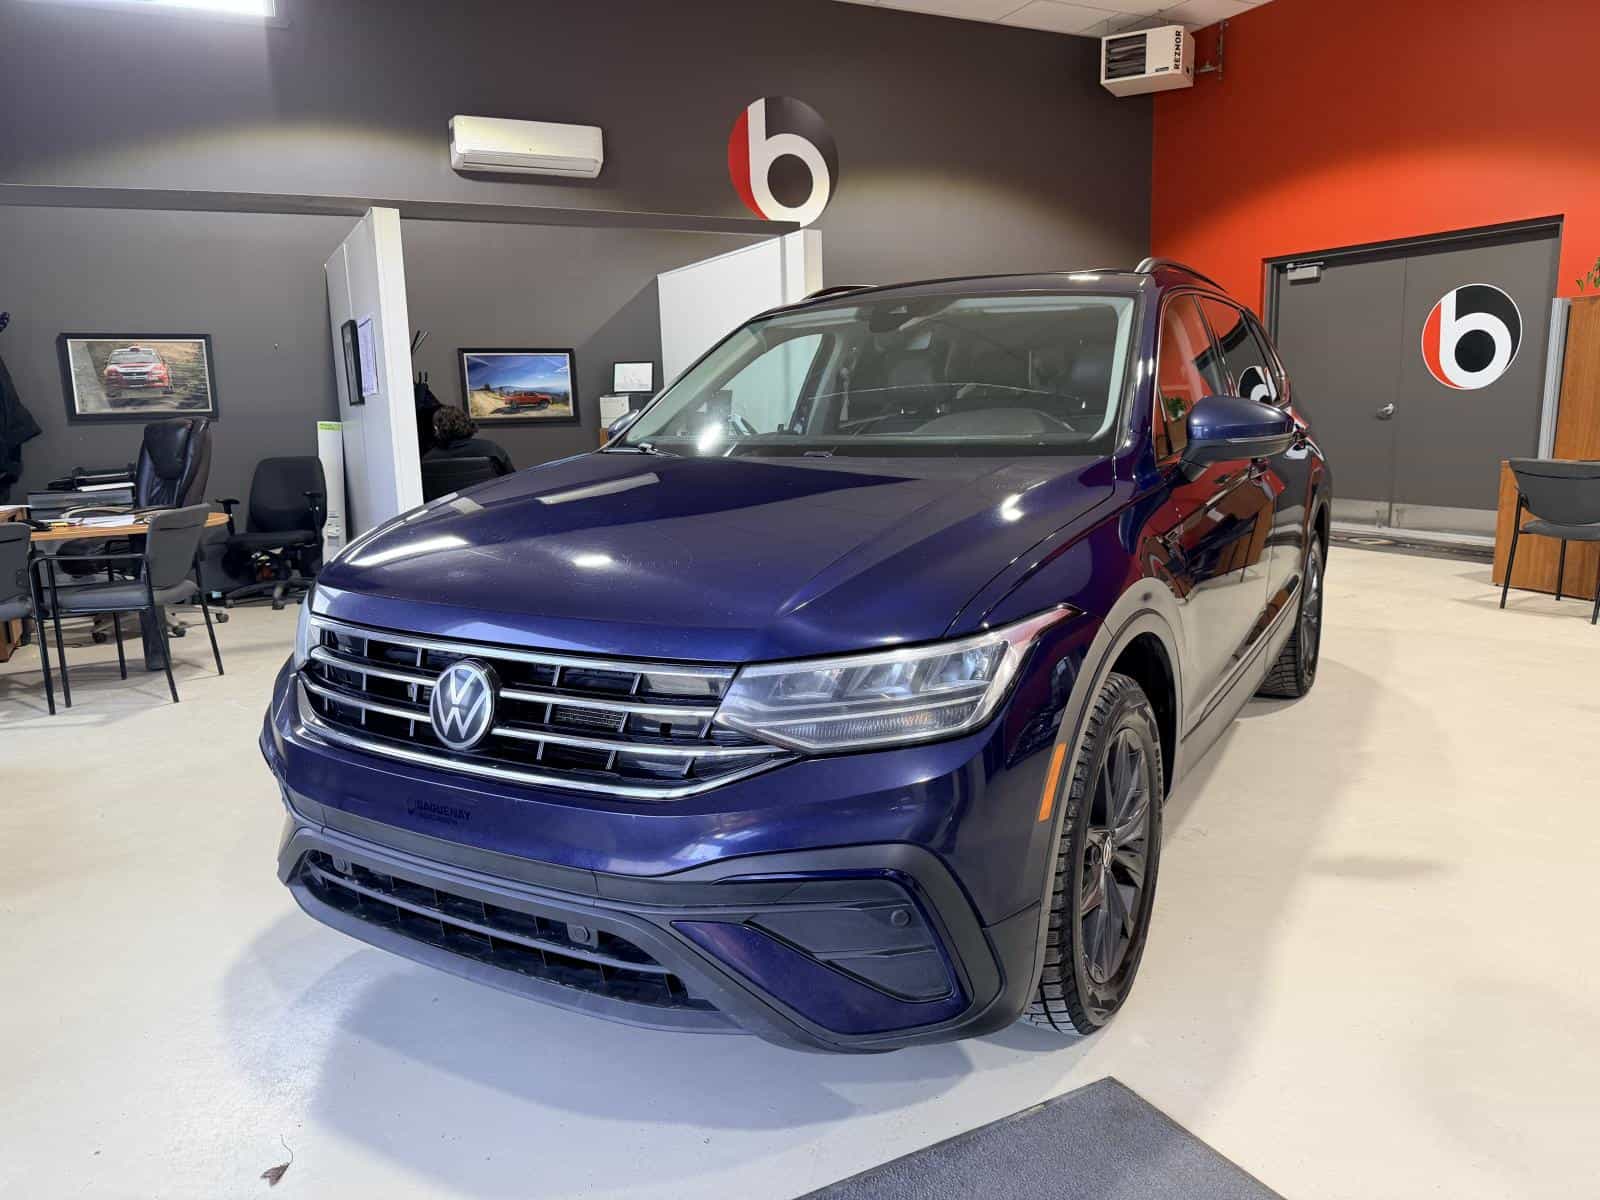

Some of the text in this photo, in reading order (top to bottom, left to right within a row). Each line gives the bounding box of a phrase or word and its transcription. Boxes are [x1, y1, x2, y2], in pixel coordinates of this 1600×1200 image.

[1173, 30, 1183, 70] REZNOR
[747, 97, 830, 228] b
[1439, 288, 1512, 388] b
[435, 667, 487, 739] VW
